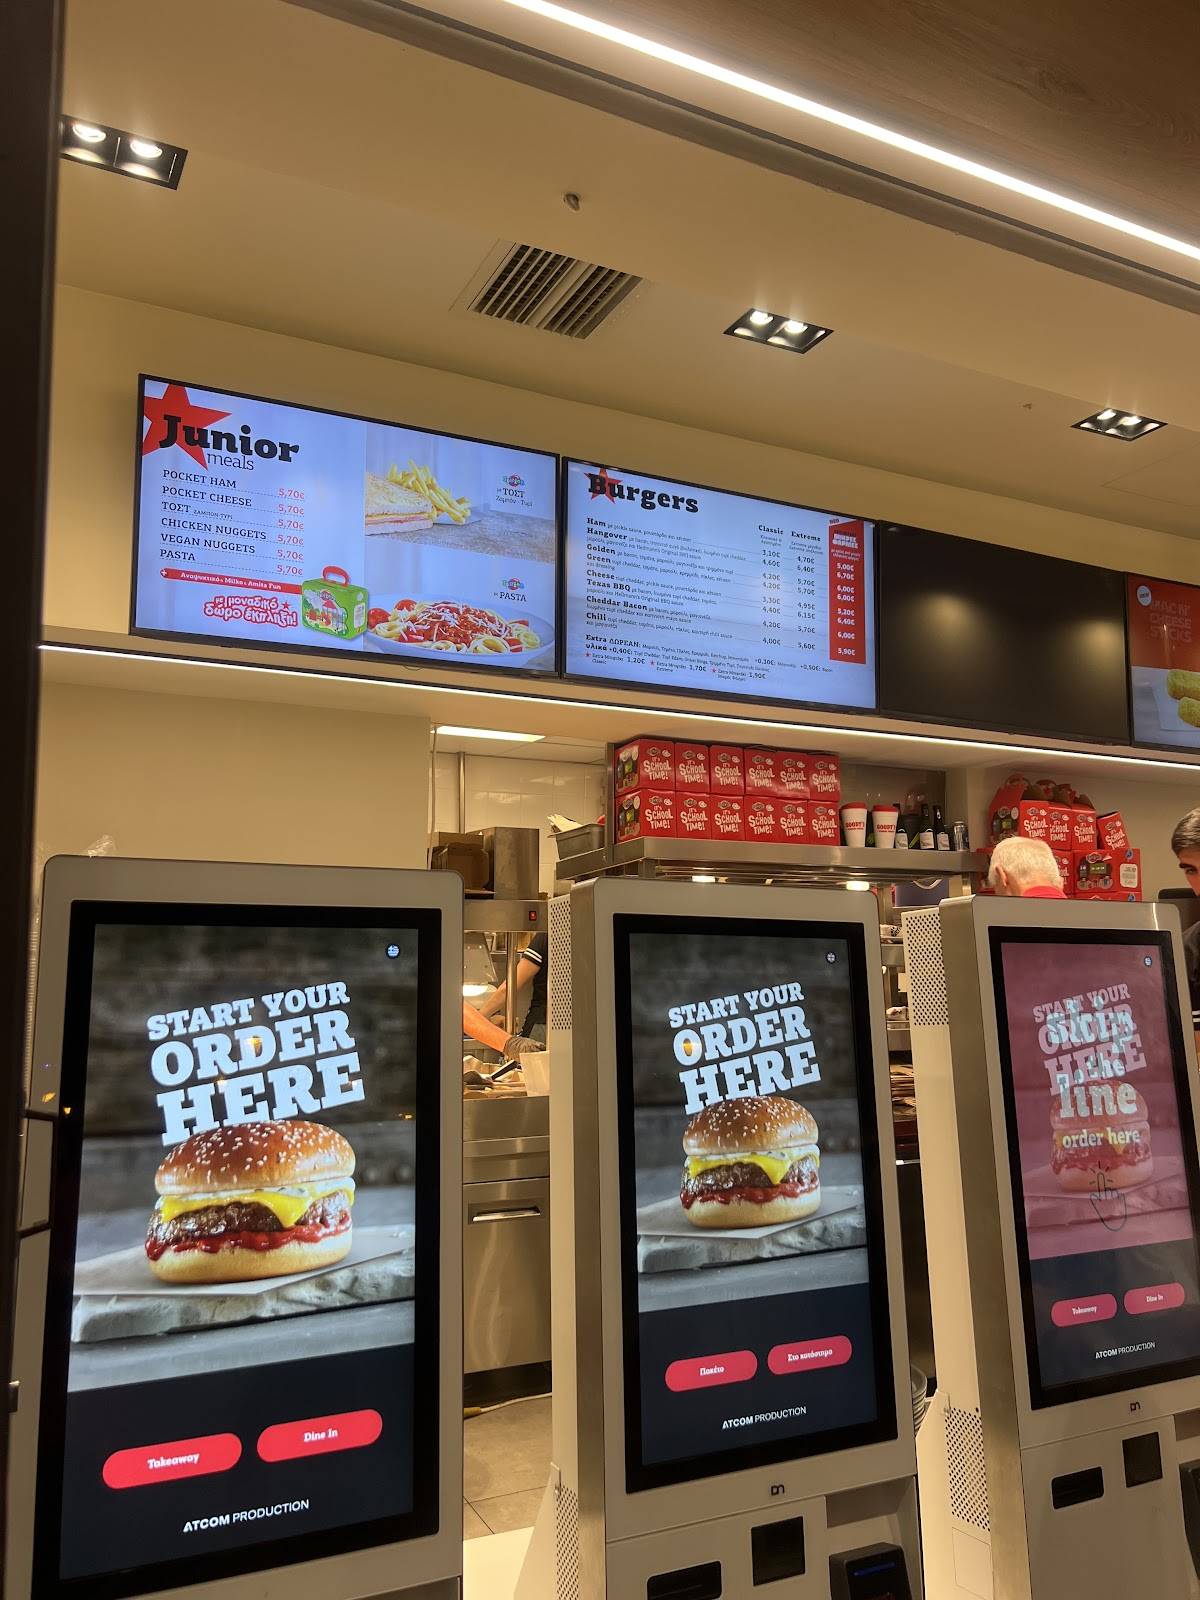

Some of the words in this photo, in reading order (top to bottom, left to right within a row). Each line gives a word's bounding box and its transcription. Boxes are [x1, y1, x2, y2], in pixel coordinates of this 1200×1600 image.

[160, 414, 300, 462] Junior
[207, 451, 254, 471] meals
[162, 469, 208, 483] POCKET
[210, 477, 237, 489] HAM
[278, 488, 305, 500] 5,70€
[588, 473, 699, 513] Burgers
[161, 485, 207, 499] POCKET
[209, 492, 252, 507] CHEESE
[278, 503, 305, 515] 5,70€
[160, 501, 191, 513] ΤΟΣΤ
[277, 518, 304, 530] 5,70€
[586, 517, 606, 528] Ham
[160, 517, 212, 533] CHICKEN
[215, 525, 268, 542] NUGGETS
[277, 534, 304, 547] 5,70€
[586, 527, 628, 541] Hangover
[758, 525, 784, 535] Classic
[791, 531, 822, 542] Extreme
[160, 533, 201, 548] VEGAN
[203, 539, 256, 554] NUGGETS
[276, 549, 304, 563] 5,70€
[586, 543, 616, 555] Golden
[762, 550, 781, 558] 3,10€
[159, 548, 196, 563] PASTA
[276, 564, 303, 577] 5,70€
[586, 553, 611, 564] Green
[586, 569, 615, 580] Cheese
[762, 573, 781, 581] 4,20€
[586, 578, 611, 589] Texas
[613, 582, 631, 593] BBQ
[762, 582, 781, 590] 4,20€
[499, 591, 527, 602] PASTA
[586, 595, 620, 607] Cheddar
[623, 600, 648, 611] Bacon
[586, 612, 607, 622] Chili
[762, 621, 781, 629] 4,20€
[586, 634, 607, 644] Extra
[762, 638, 781, 646] 4,00€
[837, 648, 855, 657] 5,90€
[643, 759, 671, 773] SCHOOL
[679, 763, 706, 776] SCHOOL
[714, 765, 742, 778] SCHOOL
[649, 770, 669, 781] TIME!
[684, 774, 704, 784] TIME!
[719, 776, 739, 786] TIME!
[748, 768, 775, 781] SCHOOL
[780, 771, 807, 783] SCHOOL
[812, 773, 838, 785] SCHOOL
[752, 778, 773, 788] TIME!
[785, 781, 804, 791] TIME!
[816, 783, 835, 793] TIME!
[644, 808, 674, 822] SCHOOL
[680, 811, 708, 824] SCHOOL
[714, 812, 742, 825] SCHOOL
[748, 815, 775, 828] SCHOOL
[650, 819, 671, 830] TIME!
[685, 821, 706, 832] TIME!
[719, 823, 739, 833] TIME!
[780, 816, 807, 829] SCHOOL
[812, 818, 838, 831] SCHOOL
[1023, 818, 1048, 832] SCHOOL
[752, 825, 773, 835] TIME!
[784, 826, 804, 837] TIME!
[816, 828, 835, 839] TIME!
[1073, 825, 1095, 837] SCHOOL
[1105, 828, 1125, 846] SCHOOL
[1086, 984, 1131, 1008] YOUR
[147, 998, 255, 1041] START
[261, 981, 351, 1019] YOUR
[668, 994, 740, 1029] START
[743, 982, 805, 1011] YOUR
[673, 1005, 811, 1066] ORDER
[150, 1010, 356, 1087] ORDER
[679, 1041, 821, 1116] HERE
[156, 1051, 365, 1147] HERE
[1056, 1073, 1138, 1118] line
[1062, 1128, 1104, 1150] order
[1108, 1126, 1141, 1147] here
[1072, 1305, 1097, 1316] Takeaway
[1146, 1294, 1157, 1304] Dine
[1157, 1293, 1164, 1302] In
[1095, 1348, 1118, 1360] ATCOM
[1118, 1341, 1156, 1356] PRODUCTION
[699, 1363, 725, 1377] Πακέτο
[721, 1414, 754, 1431] ATCOM
[754, 1404, 807, 1425] PRODUCTION
[147, 1451, 201, 1470] Takeaway
[304, 1428, 326, 1443] Dine
[327, 1426, 338, 1441] In
[183, 1513, 231, 1534] ATCOM
[232, 1499, 310, 1525] PRODUCTION
